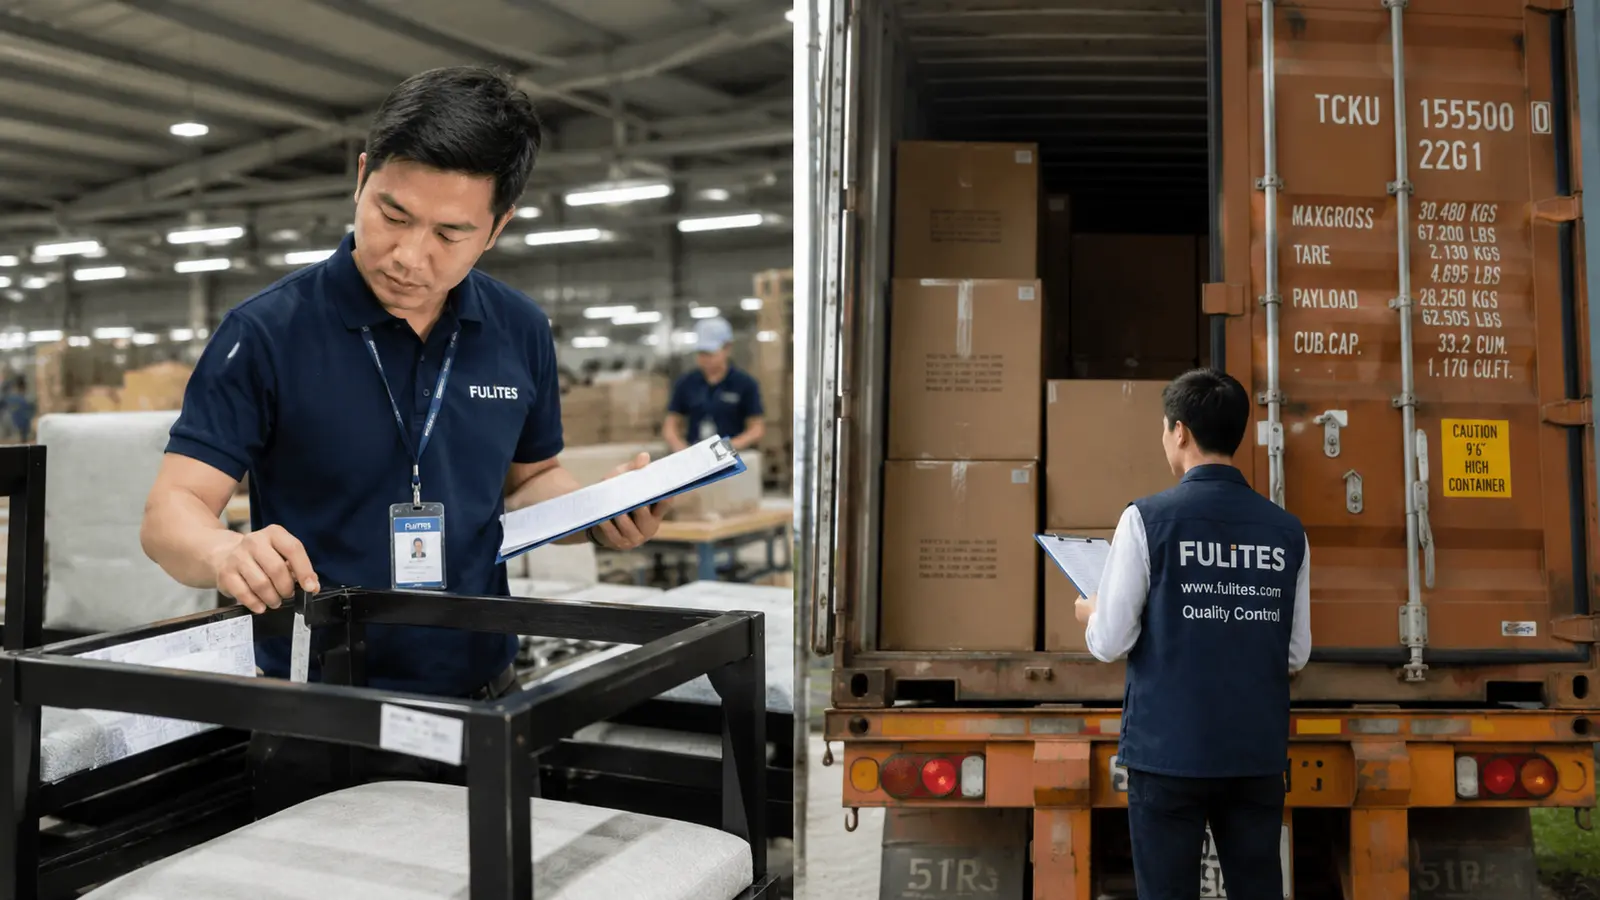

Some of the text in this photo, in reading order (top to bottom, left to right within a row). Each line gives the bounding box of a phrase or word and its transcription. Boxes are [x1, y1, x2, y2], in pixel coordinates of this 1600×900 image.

[1315, 94, 1549, 132] TCKU 155500 0
[1419, 139, 1481, 171] 22G1
[1292, 201, 1498, 229] MAXGROSS 30.480 KGS
[1418, 225, 1496, 243] 67.200 LBS
[1294, 244, 1500, 264] TARE 2.130 KGS
[1430, 264, 1501, 285] 4.695 LBS
[1293, 288, 1498, 309] PAYLOAD 28.250 KGS
[1422, 310, 1502, 328] 62.505 LBS
[1294, 332, 1361, 355] CUB.CAP.
[1438, 333, 1470, 354] 33.2
[1428, 359, 1467, 378] 1.170
[1453, 424, 1498, 439] CAUTION
[1465, 460, 1489, 475] HIGH
[1449, 478, 1505, 492] CONTAINER
[1181, 581, 1281, 598] www.fulites.com
[1182, 605, 1280, 623] Quality Control
